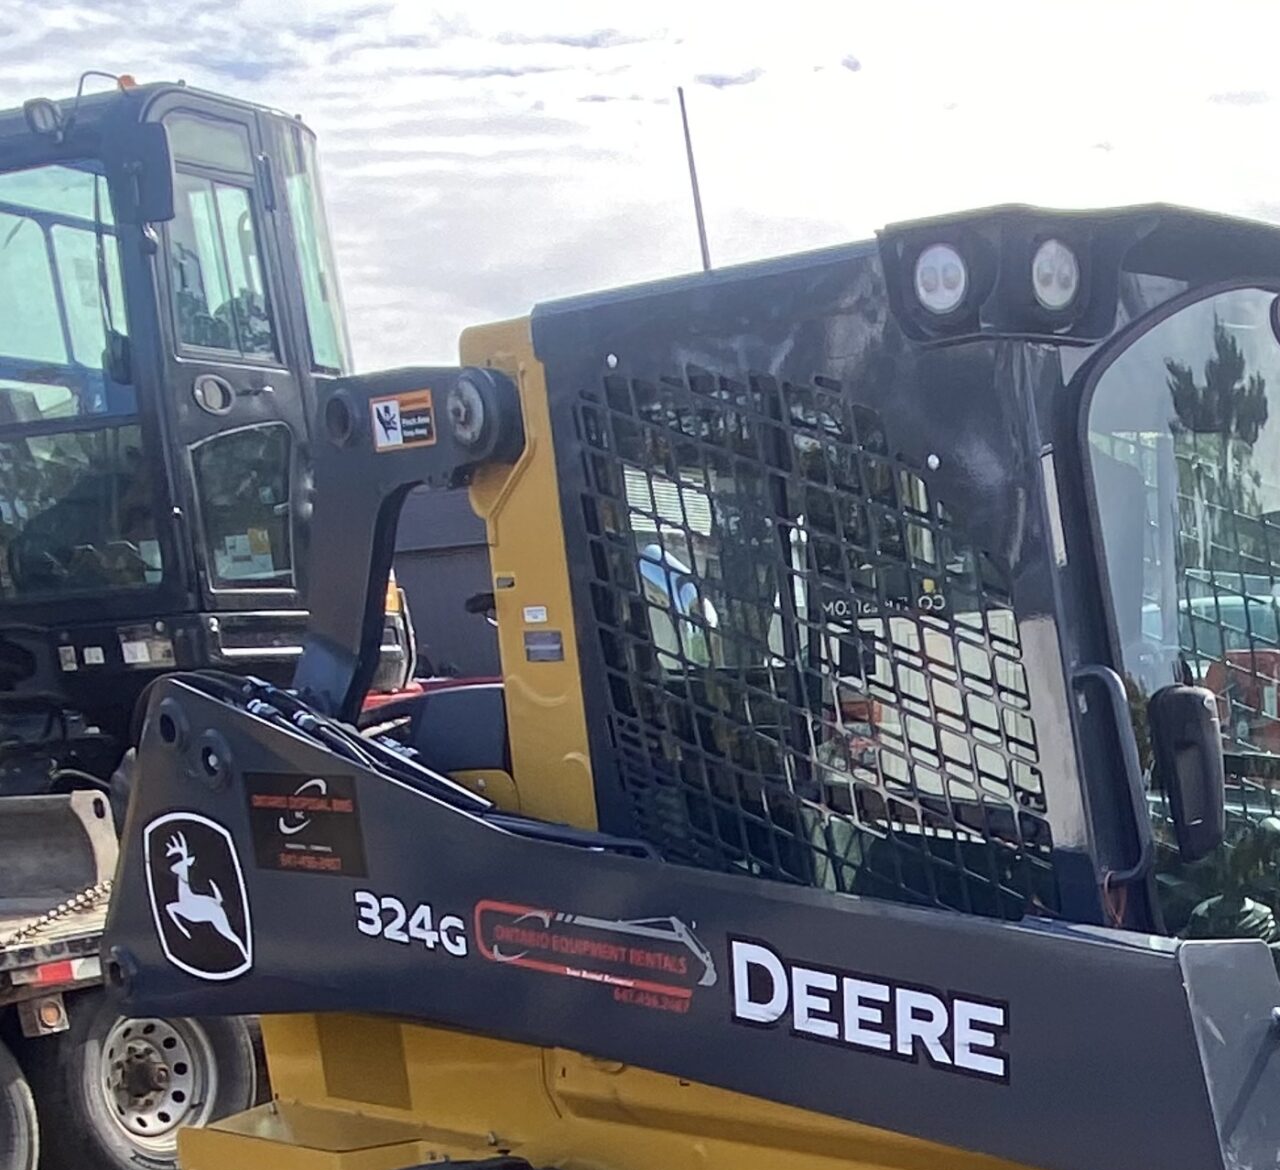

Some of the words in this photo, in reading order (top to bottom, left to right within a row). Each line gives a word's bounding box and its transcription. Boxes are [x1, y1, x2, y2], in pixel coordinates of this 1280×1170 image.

[355, 891, 467, 955] 324G
[551, 935, 627, 962] EQUIPMENT
[628, 947, 687, 975] RENTALS
[732, 940, 1004, 1076] DEERE
